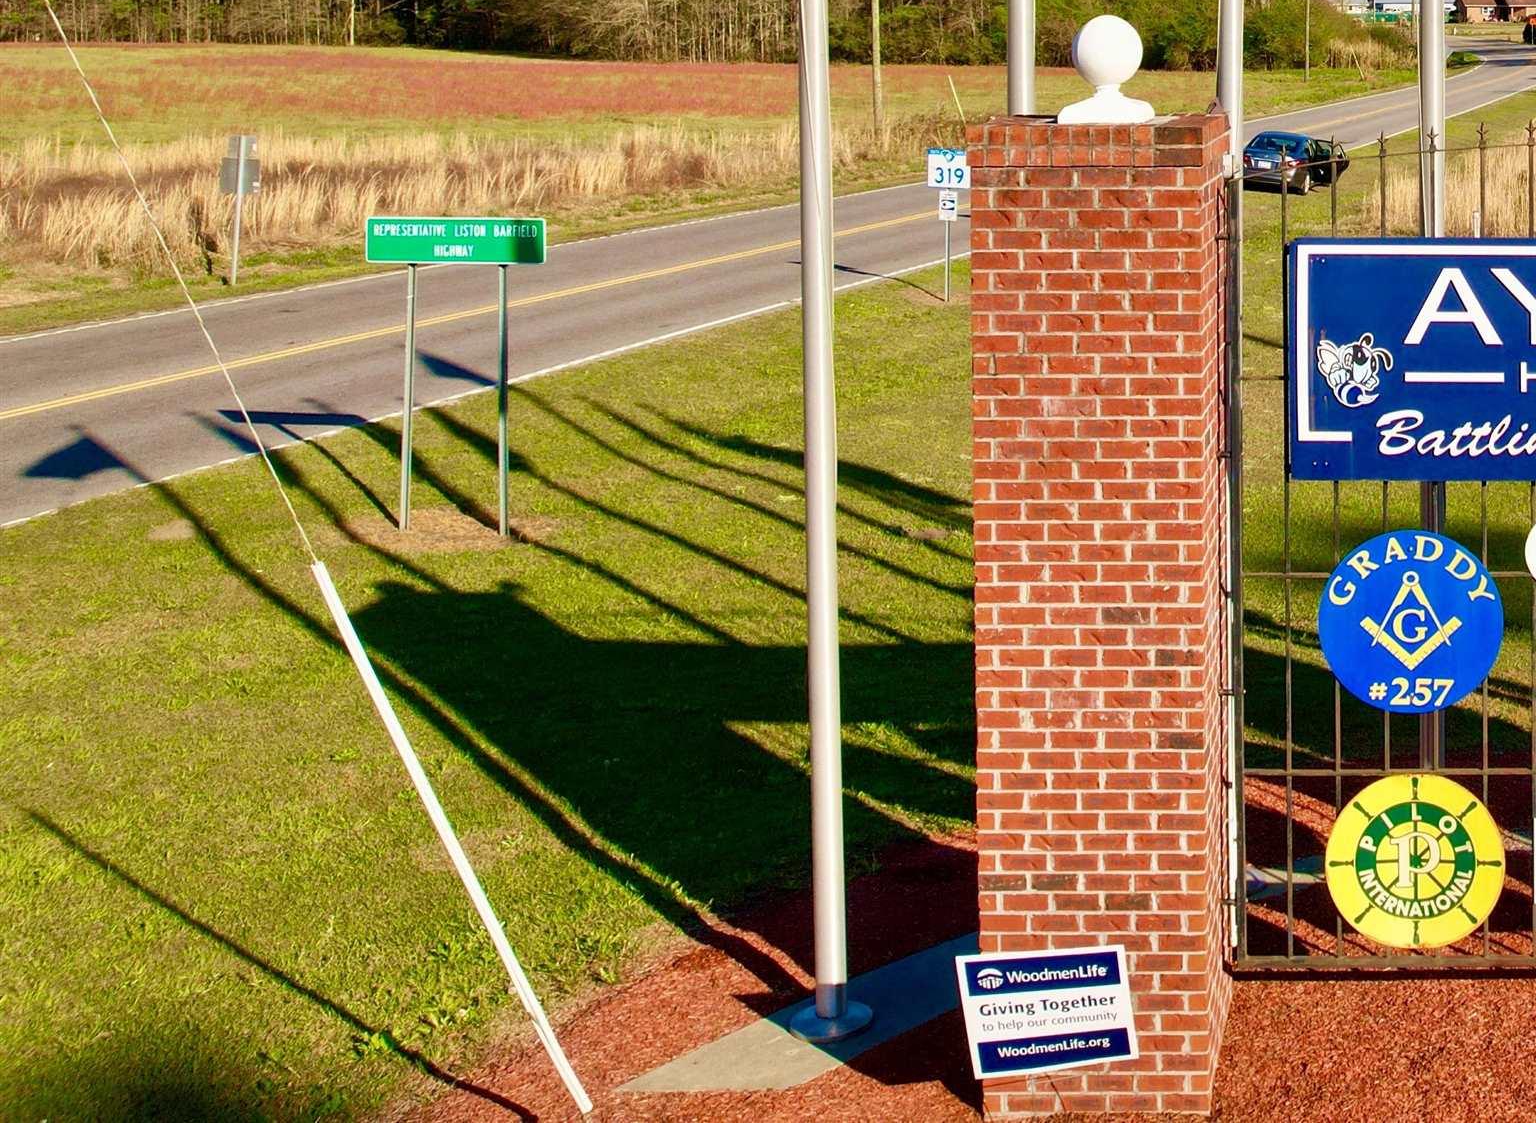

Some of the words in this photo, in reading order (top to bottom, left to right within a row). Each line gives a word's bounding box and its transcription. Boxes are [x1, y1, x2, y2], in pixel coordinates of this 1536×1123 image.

[935, 167, 964, 184] 319
[373, 223, 447, 237] REPRESENTATIVE
[454, 224, 486, 237] LISTON
[493, 225, 537, 238] BARFIELD
[433, 244, 474, 257] HIGHWAY
[1328, 535, 1496, 606] GRADDY
[1392, 608, 1428, 643] G
[1368, 677, 1455, 707] #257
[1359, 802, 1473, 853] PILOT
[1390, 831, 1441, 889] P
[1359, 869, 1473, 917] INTERNATIONAL
[1006, 964, 1107, 984] WoodmenLife
[979, 1002, 1036, 1017] Giving
[1039, 995, 1117, 1012] Together
[982, 1022, 994, 1032] to
[997, 1019, 1023, 1032] help
[1027, 1017, 1048, 1028] our
[1051, 1011, 1118, 1026] community
[997, 1037, 1111, 1058] WoodmenLife.org
